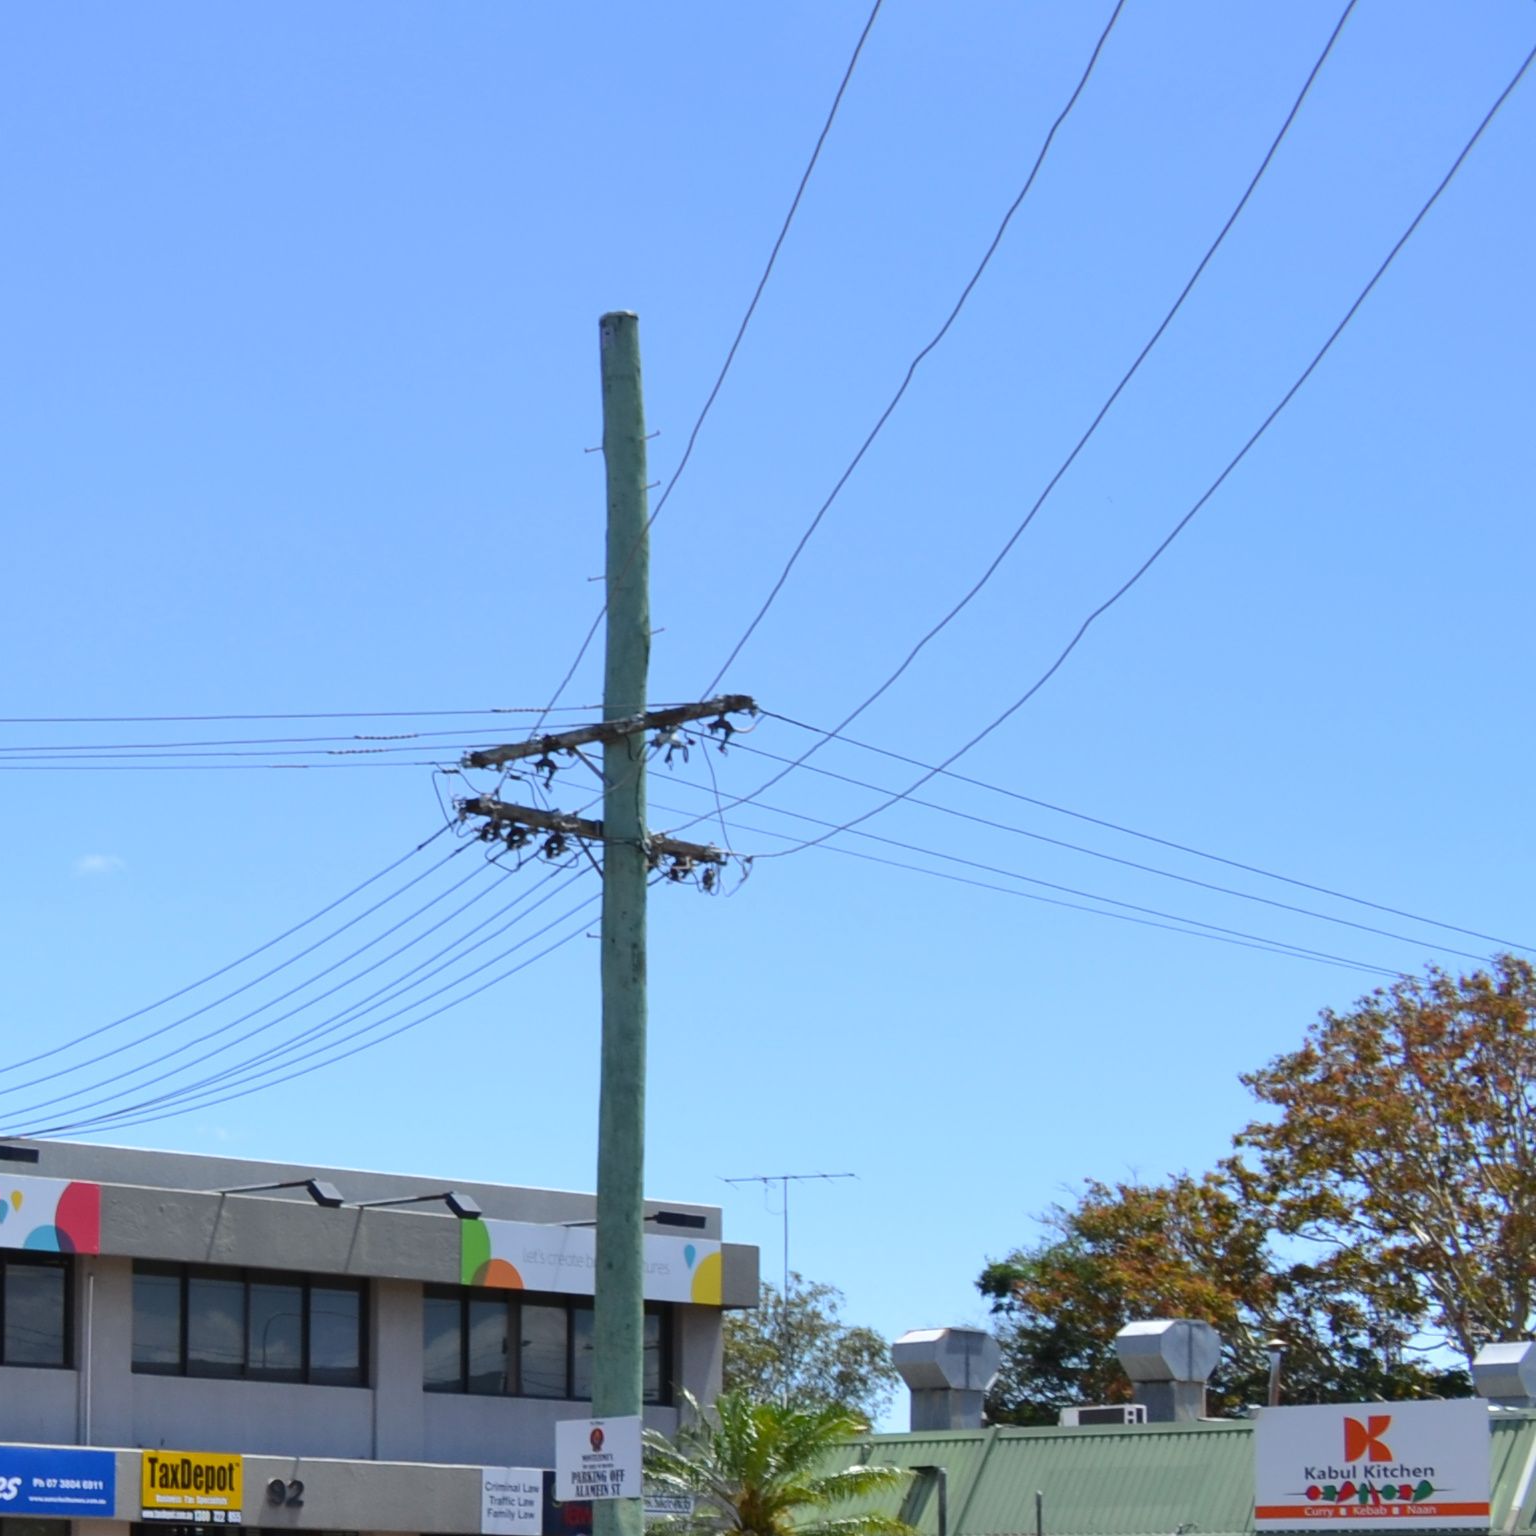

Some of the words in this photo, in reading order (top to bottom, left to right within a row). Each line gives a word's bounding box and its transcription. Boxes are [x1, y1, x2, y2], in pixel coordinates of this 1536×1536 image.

[148, 1457, 234, 1494] TaxDepot
[571, 1470, 607, 1484] PARKING
[610, 1469, 625, 1482] OFF
[1304, 1466, 1357, 1480] Kabul
[1364, 1464, 1435, 1479] Kitchen
[266, 1478, 305, 1508] 92
[485, 1481, 520, 1494] Criminal
[523, 1483, 539, 1493] Law
[610, 1484, 621, 1496] ST
[489, 1495, 515, 1507] Traffic
[518, 1496, 534, 1507] Law
[487, 1509, 515, 1521] Family
[518, 1509, 534, 1520] Law
[1304, 1506, 1334, 1517] Curry
[1353, 1505, 1387, 1515] Kebab
[1406, 1504, 1436, 1515] Naan
